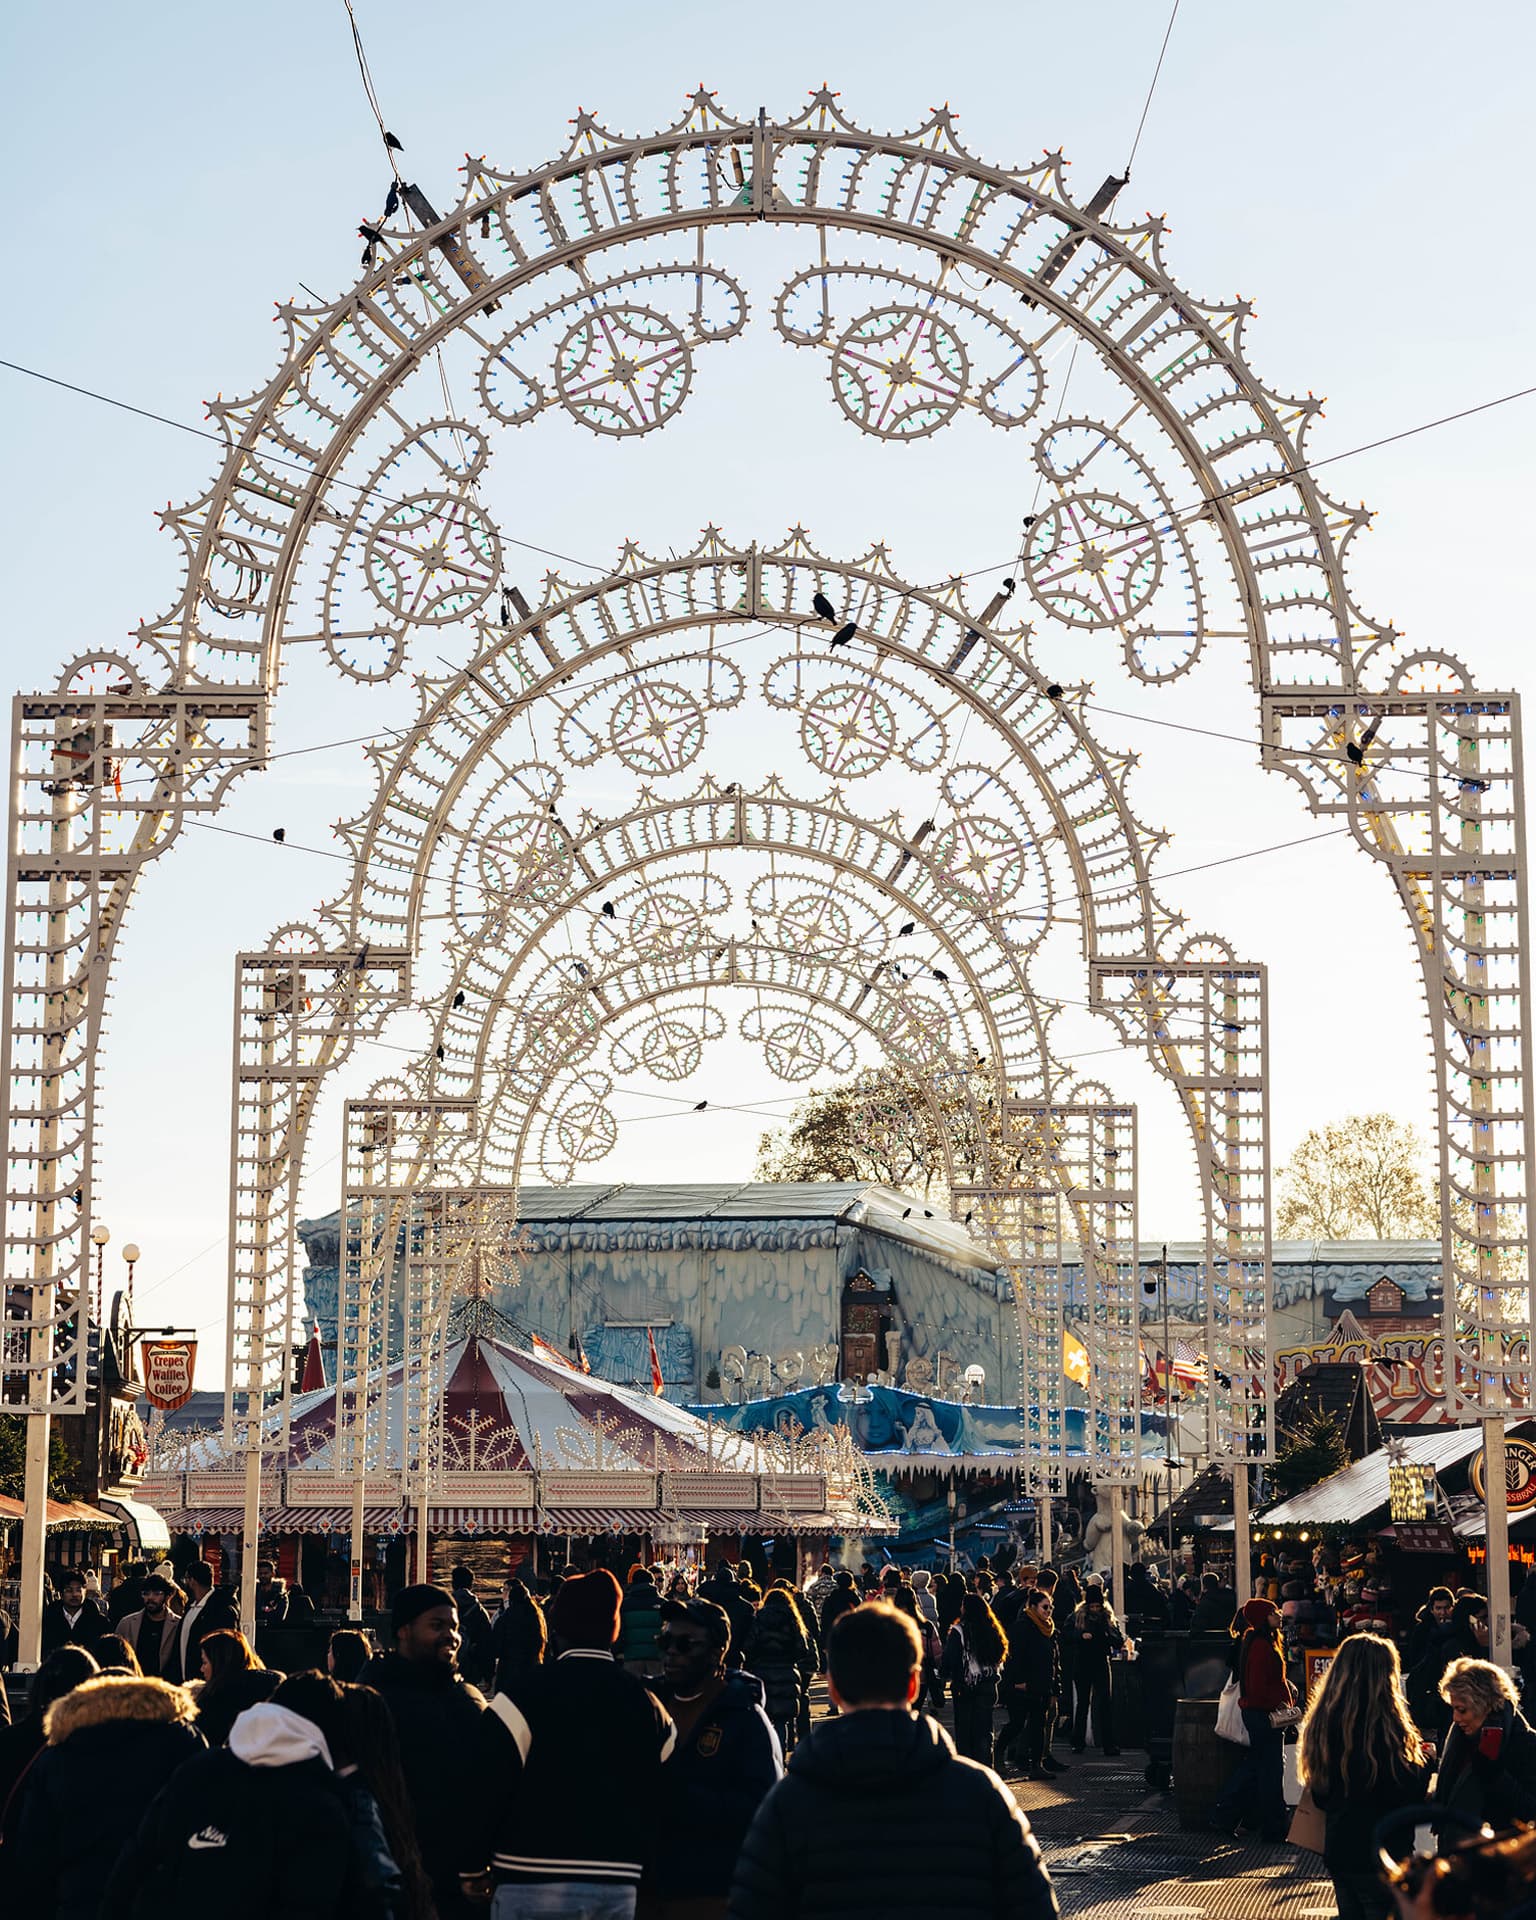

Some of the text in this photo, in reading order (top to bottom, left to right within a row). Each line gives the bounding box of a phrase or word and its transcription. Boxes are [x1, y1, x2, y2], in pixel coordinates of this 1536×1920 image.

[154, 1356, 184, 1369] Crepes
[152, 1369, 186, 1381] Waffles
[154, 1384, 183, 1395] Coffee
